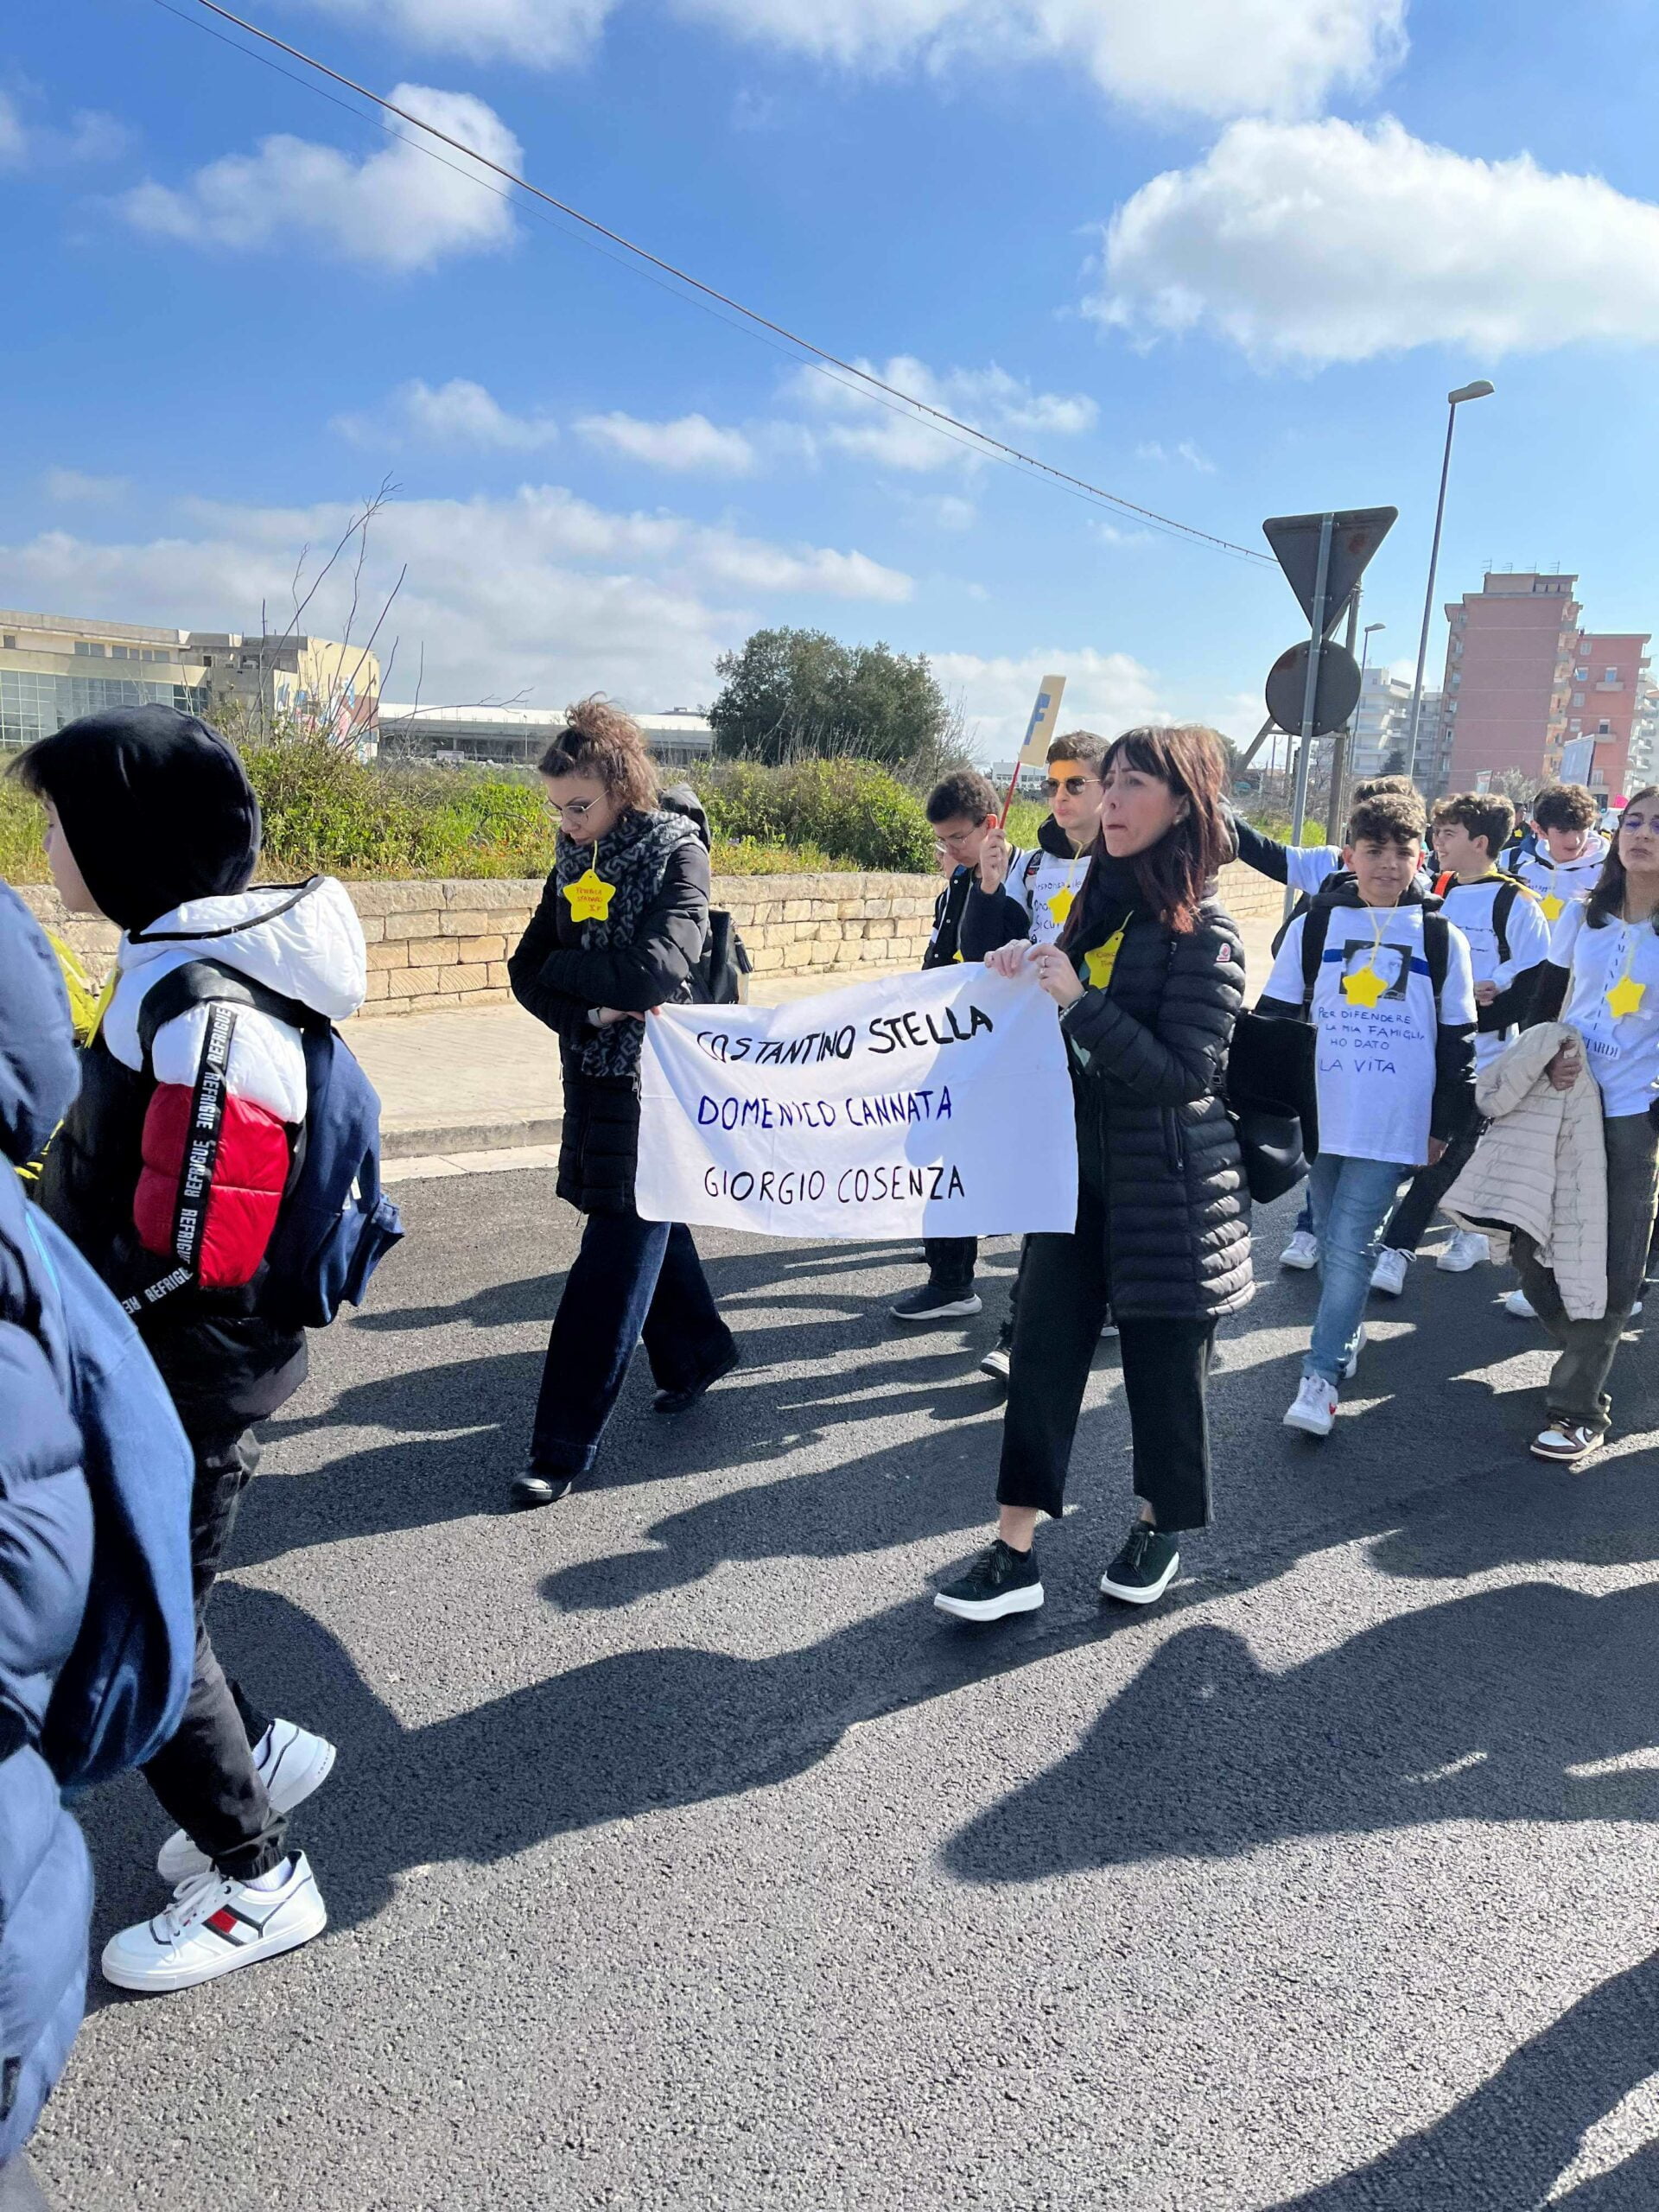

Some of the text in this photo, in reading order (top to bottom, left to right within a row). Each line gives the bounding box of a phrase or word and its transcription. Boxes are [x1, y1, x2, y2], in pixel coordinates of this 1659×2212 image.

[207, 1007, 232, 1065] REFRIGUE
[696, 1005, 994, 1065] COSTANTINO STELLA
[1341, 1010, 1412, 1025] DIFENDERE
[1368, 1025, 1425, 1041] FAMIGLI
[1319, 1058, 1344, 1072] LA
[1331, 1038, 1390, 1051] HO DATO
[195, 1071, 220, 1130] REFRIGUE
[697, 1085, 952, 1131] DOMENICO CANNATA
[184, 1139, 210, 1198] REFRIGUE
[704, 1165, 965, 1205] GIORGIO COSENZA
